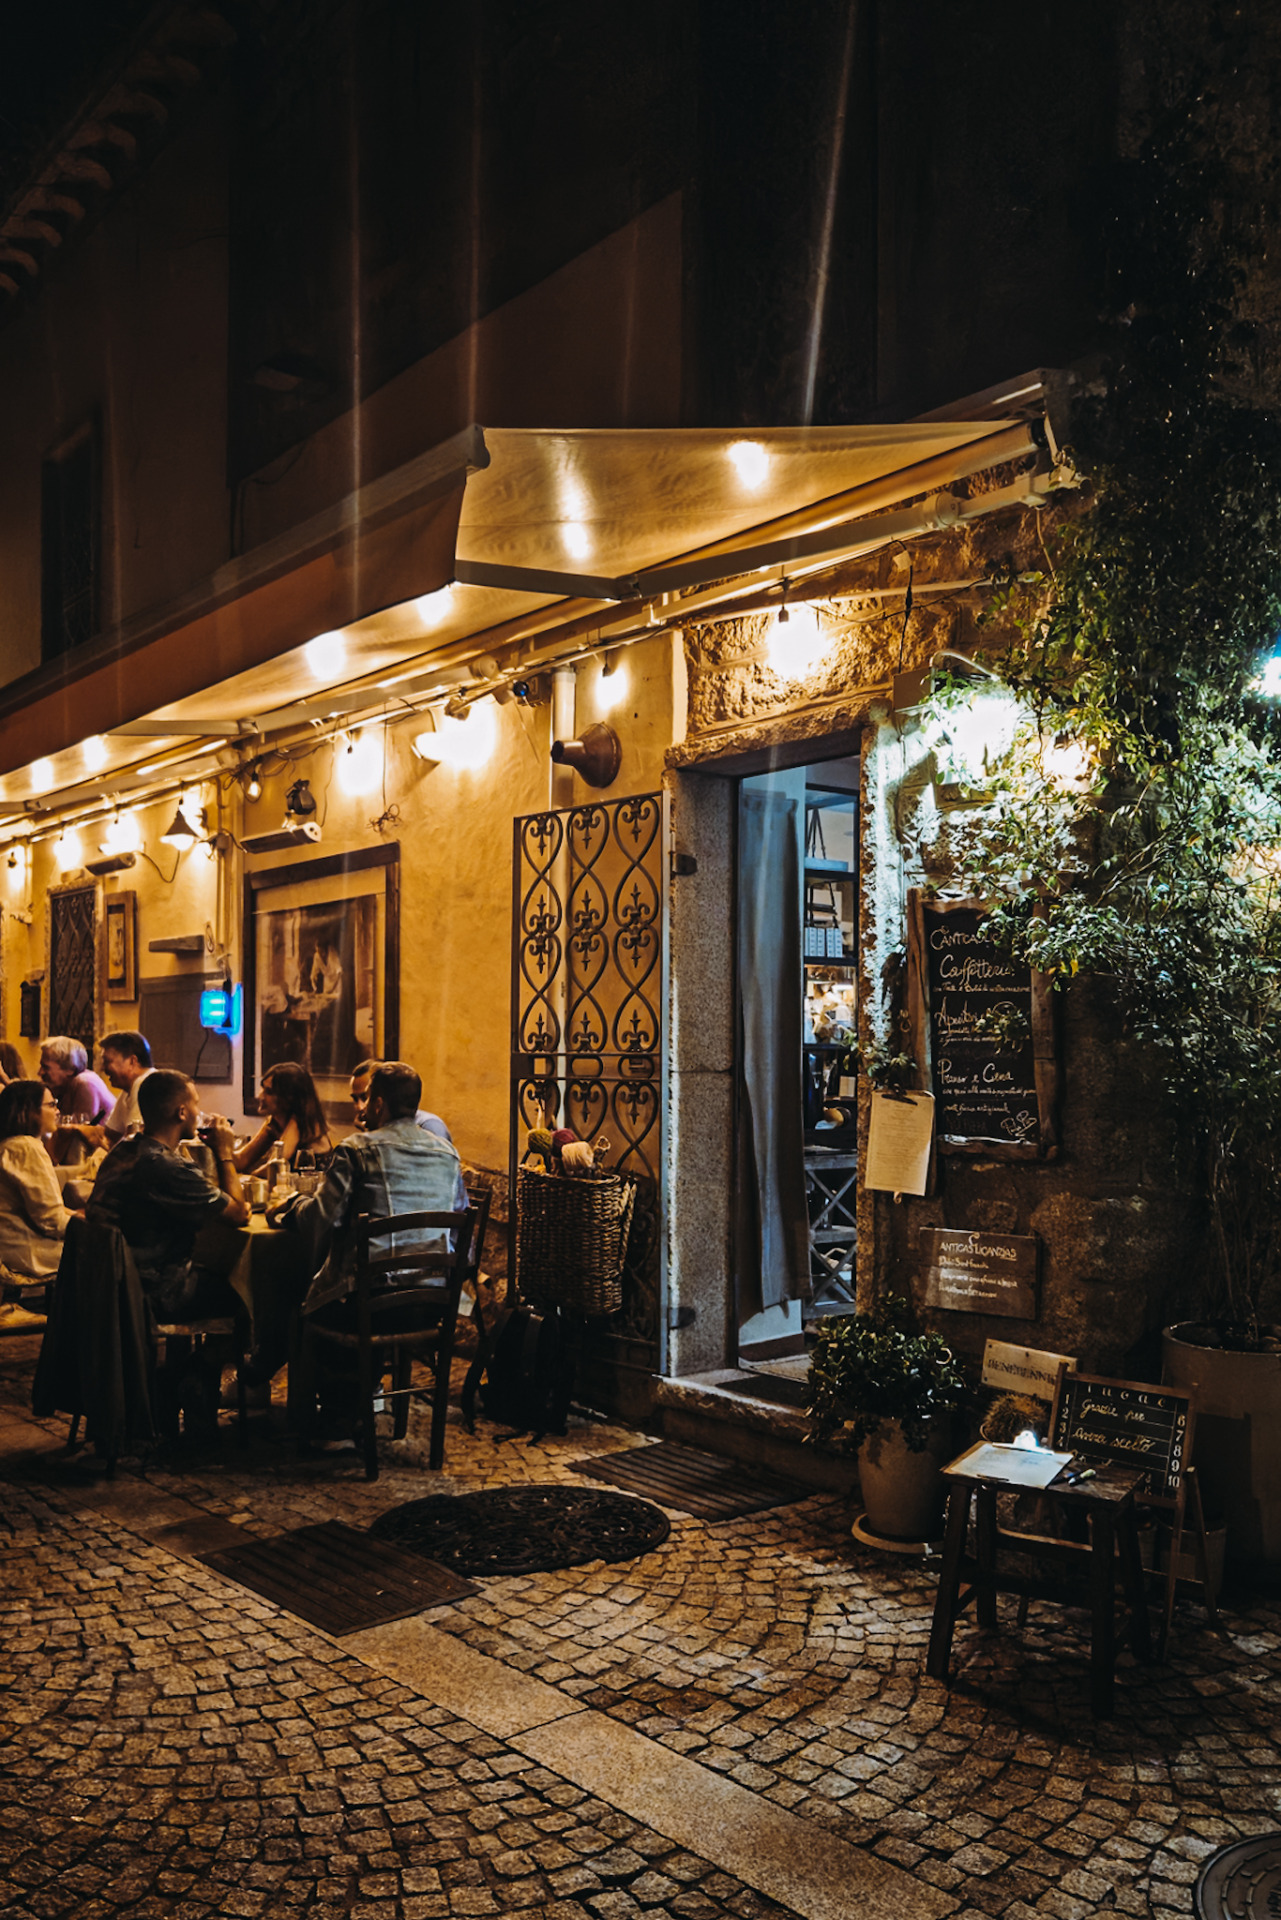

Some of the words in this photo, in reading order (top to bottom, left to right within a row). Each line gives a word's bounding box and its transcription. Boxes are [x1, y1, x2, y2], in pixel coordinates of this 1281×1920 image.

[982, 1062, 1015, 1083] Cena
[1061, 1407, 1069, 1419] 2
[1080, 1398, 1119, 1419] Grazie
[1059, 1421, 1067, 1434] 3
[1177, 1414, 1186, 1427] 6
[1175, 1429, 1184, 1442] 7
[1172, 1444, 1182, 1458] 8
[1171, 1459, 1181, 1473] 9
[1168, 1474, 1181, 1488] 10
